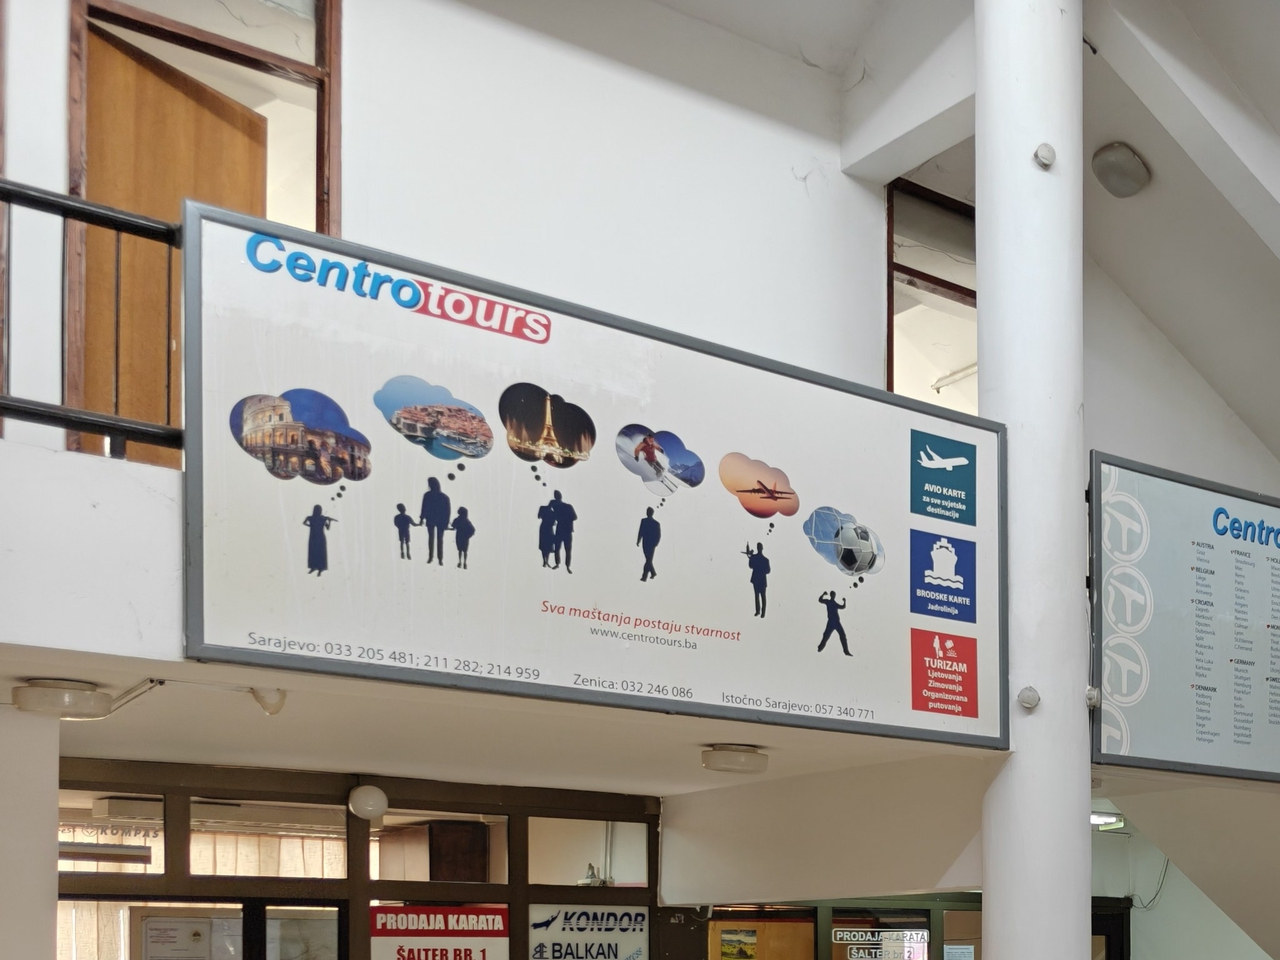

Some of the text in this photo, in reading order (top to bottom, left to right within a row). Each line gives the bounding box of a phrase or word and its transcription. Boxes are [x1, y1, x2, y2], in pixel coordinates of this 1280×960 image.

[246, 232, 550, 342] Centrotours
[924, 483, 966, 500] AVIO KARTE
[926, 505, 960, 519] destinacije
[1196, 541, 1215, 550] AUSTRIA
[1234, 550, 1251, 558] FRANCE
[1195, 566, 1215, 575] BELGIUM
[916, 588, 971, 606] BRODSKE KARTE
[1195, 598, 1214, 607] CROATIA
[927, 602, 959, 616] Jadrolinija
[541, 600, 743, 642] Sva maštanja postaju stvarnost
[590, 626, 698, 651] www.centrotours.ba
[247, 631, 541, 681] Sarajevo: 033 205 481; 211 282; 214 959
[1233, 658, 1256, 667] GERMANY
[924, 656, 968, 673] TURIZAM
[928, 669, 963, 683] Ljetovanja
[573, 672, 694, 699] Zenica: 032 246 086
[928, 679, 963, 692] Zimovanja
[1195, 684, 1217, 693] DENMARK
[922, 688, 969, 703] Organizovana
[722, 691, 876, 720] Istočno Sarajevo: 057 340 771
[928, 701, 962, 714] putovanja
[100, 827, 160, 839] KOMPAS
[376, 913, 505, 931] PRODAJA KARATA
[561, 910, 646, 932] KONDOR
[837, 931, 928, 943] PRODAJA KARATA
[551, 942, 619, 960] BALKAN
[851, 946, 892, 960] ŠALTER
[906, 950, 913, 960] 2
